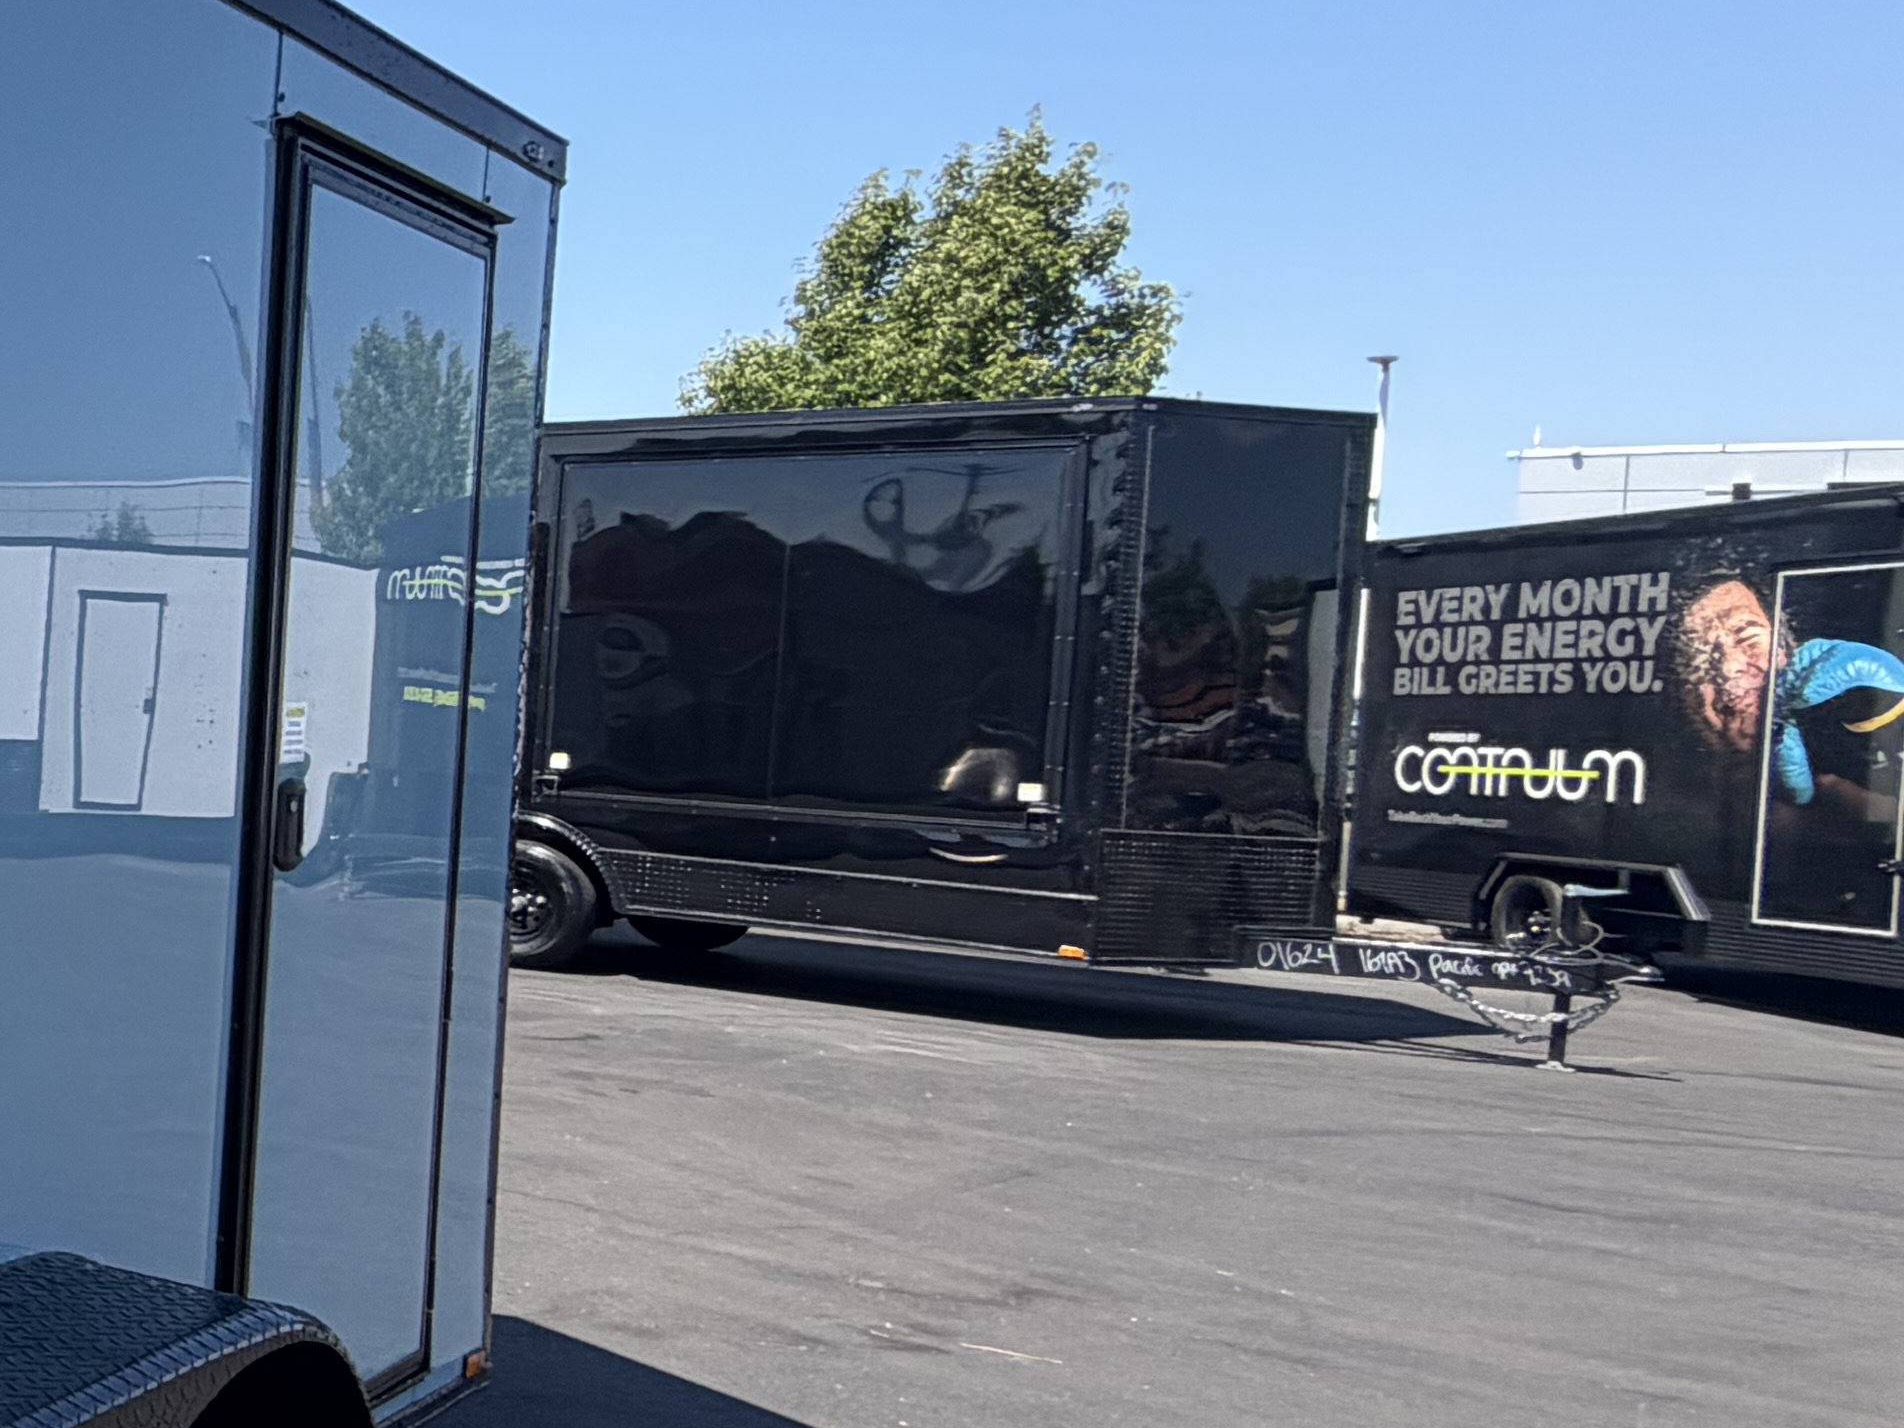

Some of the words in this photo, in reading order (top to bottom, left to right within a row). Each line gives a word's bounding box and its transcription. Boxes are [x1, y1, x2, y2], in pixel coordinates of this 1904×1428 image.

[1396, 583, 1512, 626] EVERY
[1517, 571, 1671, 619] MONTH
[1394, 625, 1492, 664] YOUR
[1500, 615, 1667, 661] ENERGY
[1393, 666, 1452, 696] BILL
[1457, 662, 1575, 695] GREETS
[1582, 660, 1664, 694] YOU.
[1256, 941, 1341, 975] 01624
